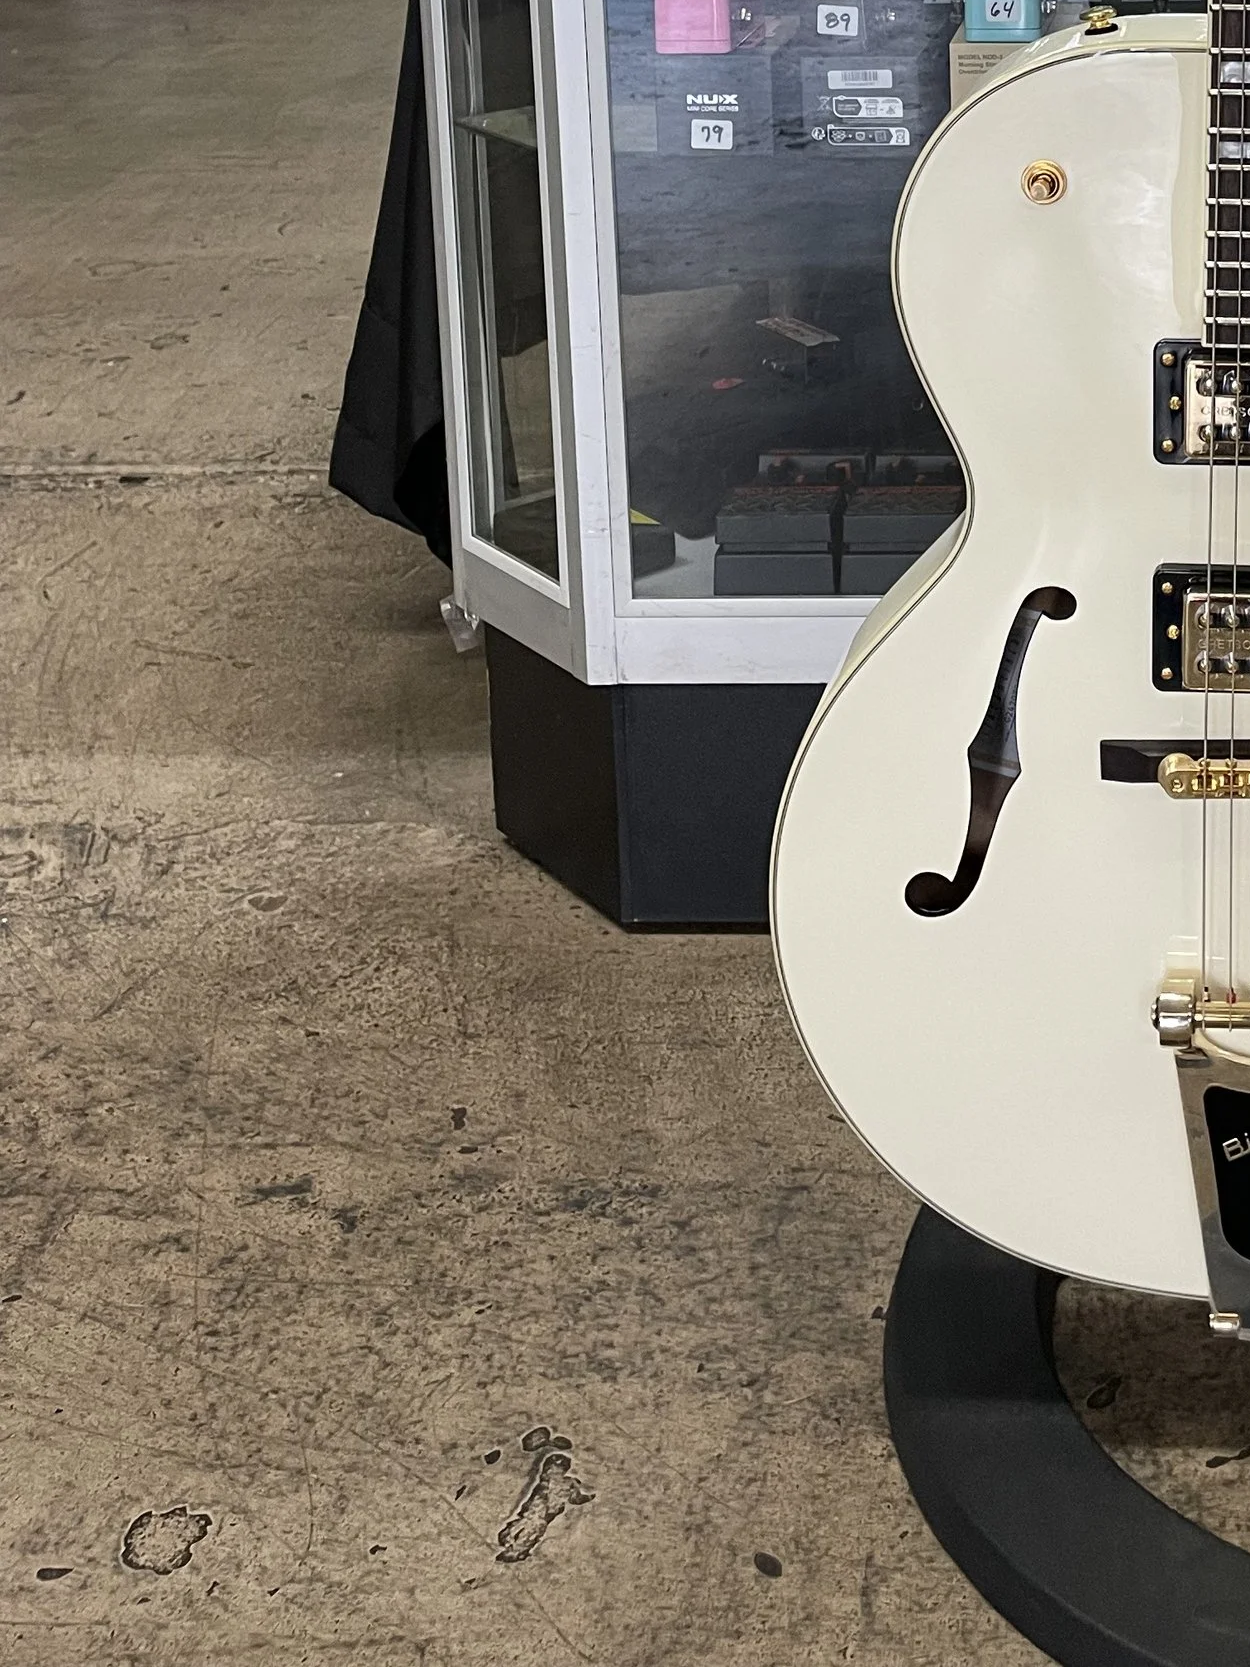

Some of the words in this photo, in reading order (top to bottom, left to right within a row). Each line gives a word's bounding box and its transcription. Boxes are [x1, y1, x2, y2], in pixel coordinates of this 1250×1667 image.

[989, 0, 1015, 20] 64
[823, 11, 851, 32] 89
[686, 93, 739, 105] NUX
[700, 124, 724, 143] 79
